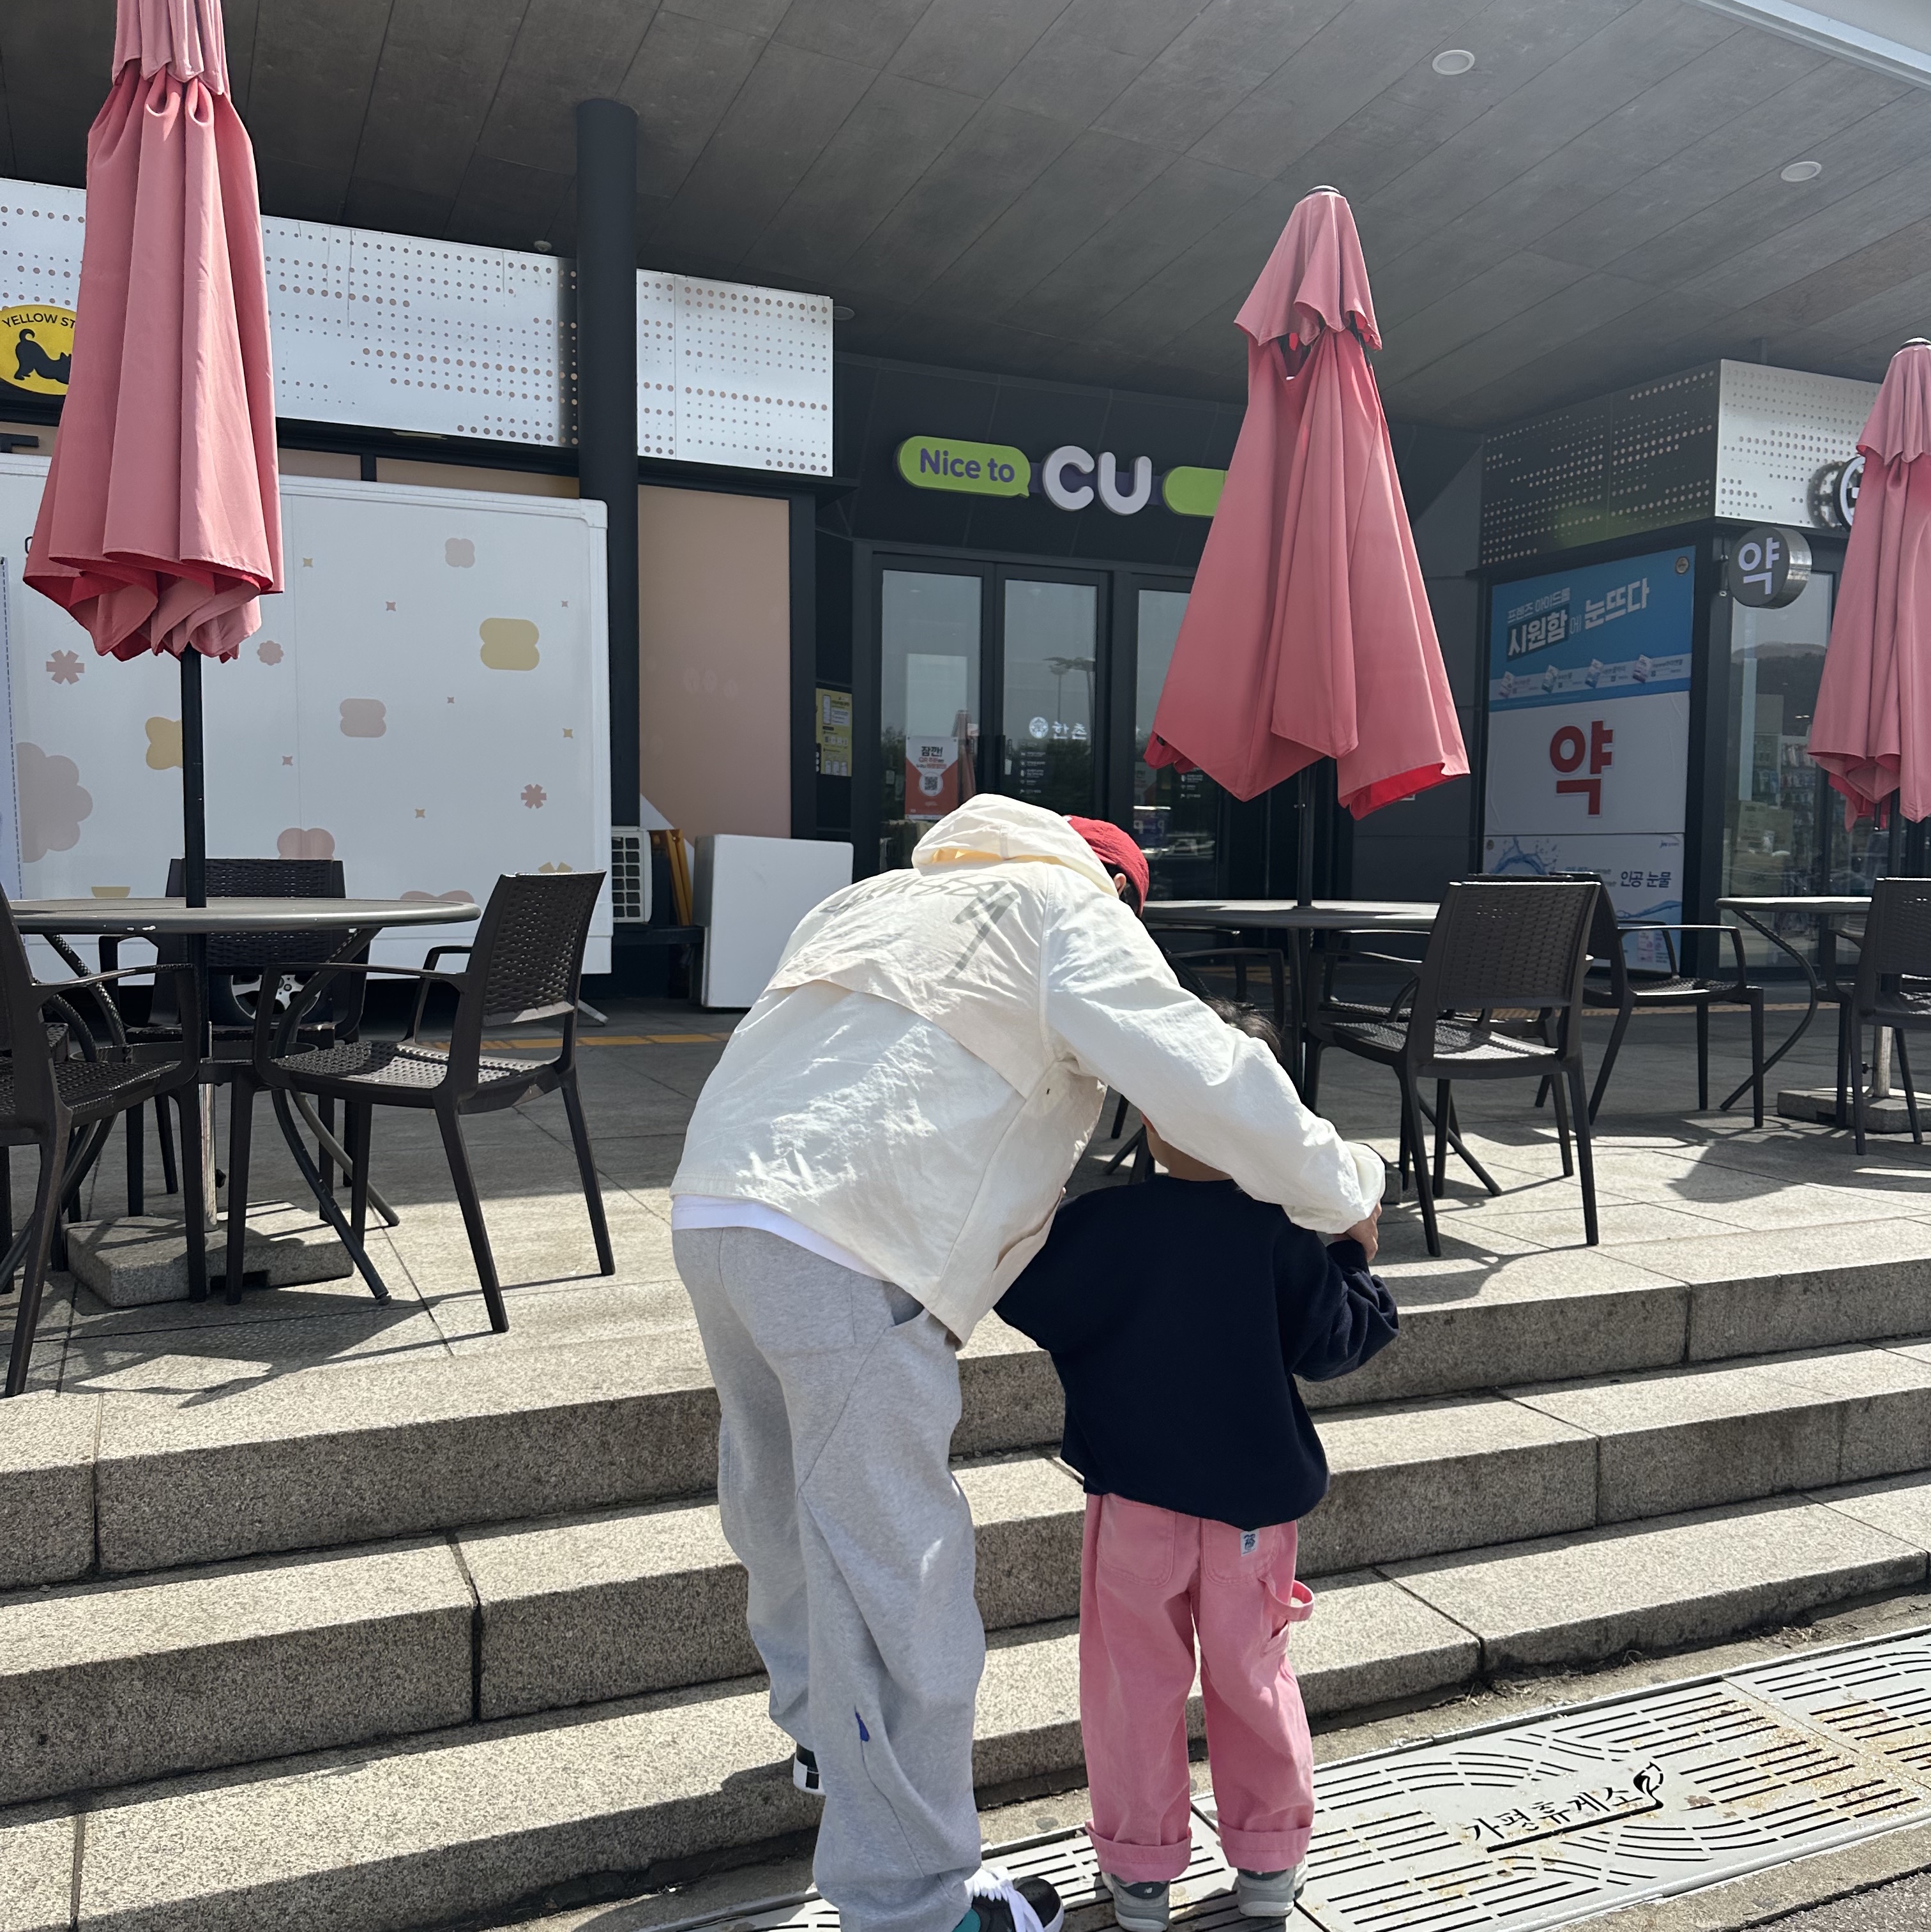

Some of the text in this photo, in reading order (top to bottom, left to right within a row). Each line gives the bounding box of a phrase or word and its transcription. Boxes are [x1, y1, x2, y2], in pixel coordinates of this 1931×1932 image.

[2, 313, 58, 327] YELLOW
[920, 445, 1152, 516] Nice to CU
[1739, 537, 1780, 595] 약
[1584, 577, 1649, 630] 눈뜨다
[1550, 720, 1613, 816] 약
[1621, 871, 1644, 888] 인공
[1646, 871, 1672, 888] 눈물
[1462, 1786, 1643, 1841] 가평휴게소
